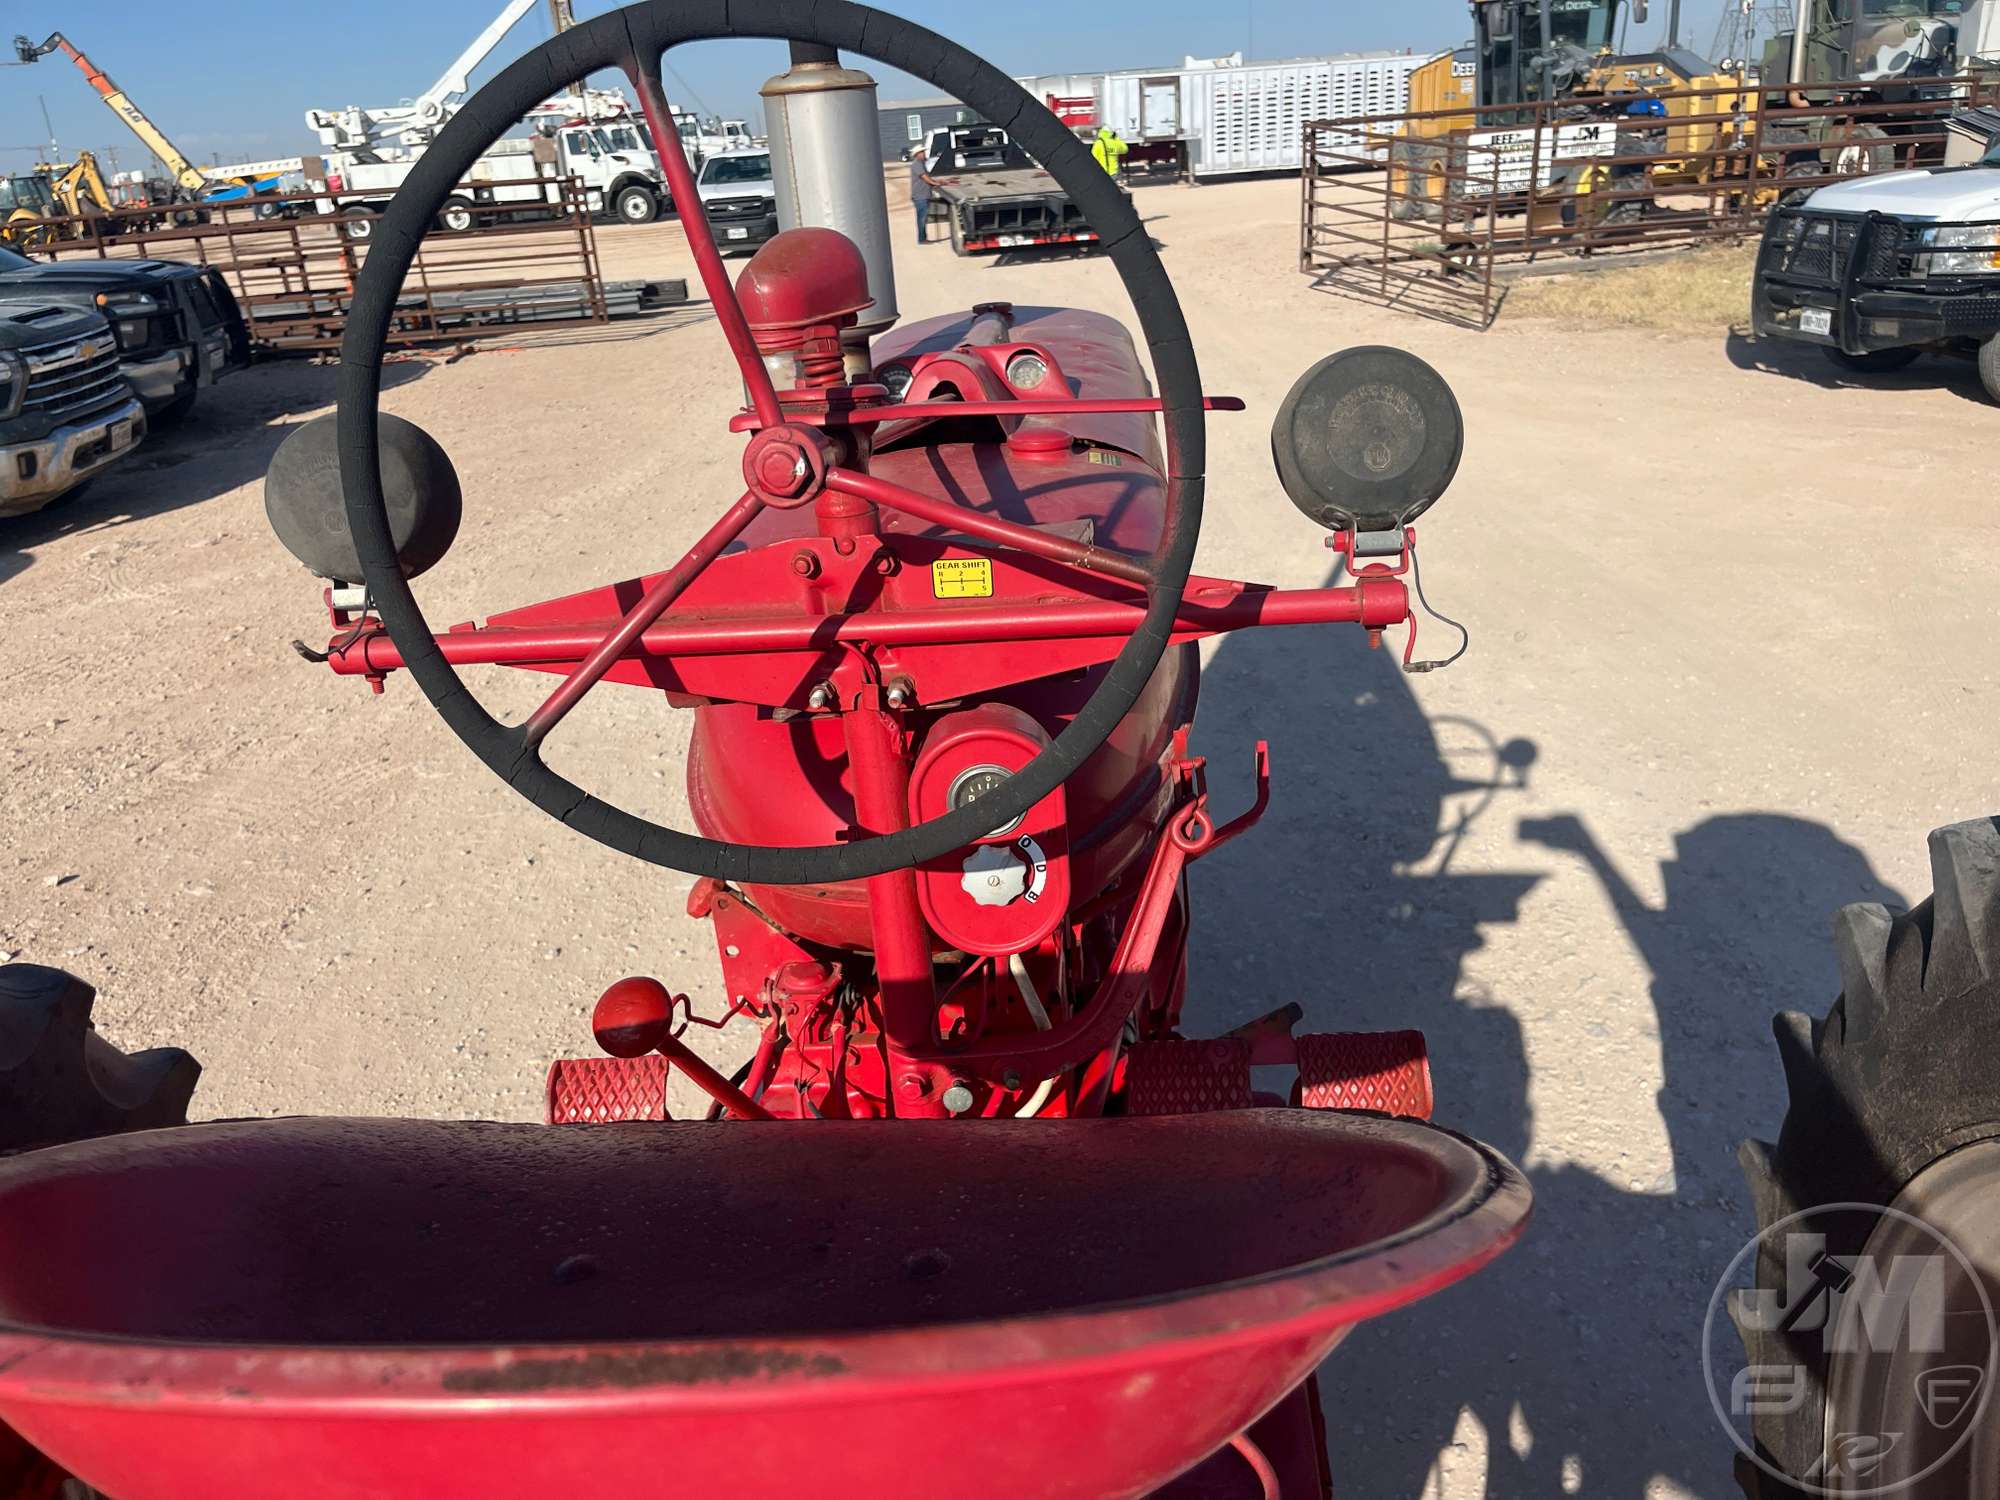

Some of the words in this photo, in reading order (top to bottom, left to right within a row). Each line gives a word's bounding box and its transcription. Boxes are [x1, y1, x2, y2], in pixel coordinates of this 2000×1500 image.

[936, 562, 960, 570] GEAR
[961, 561, 986, 569] SHIFT
[1036, 864, 1047, 873] D
[1028, 890, 1039, 902] B
